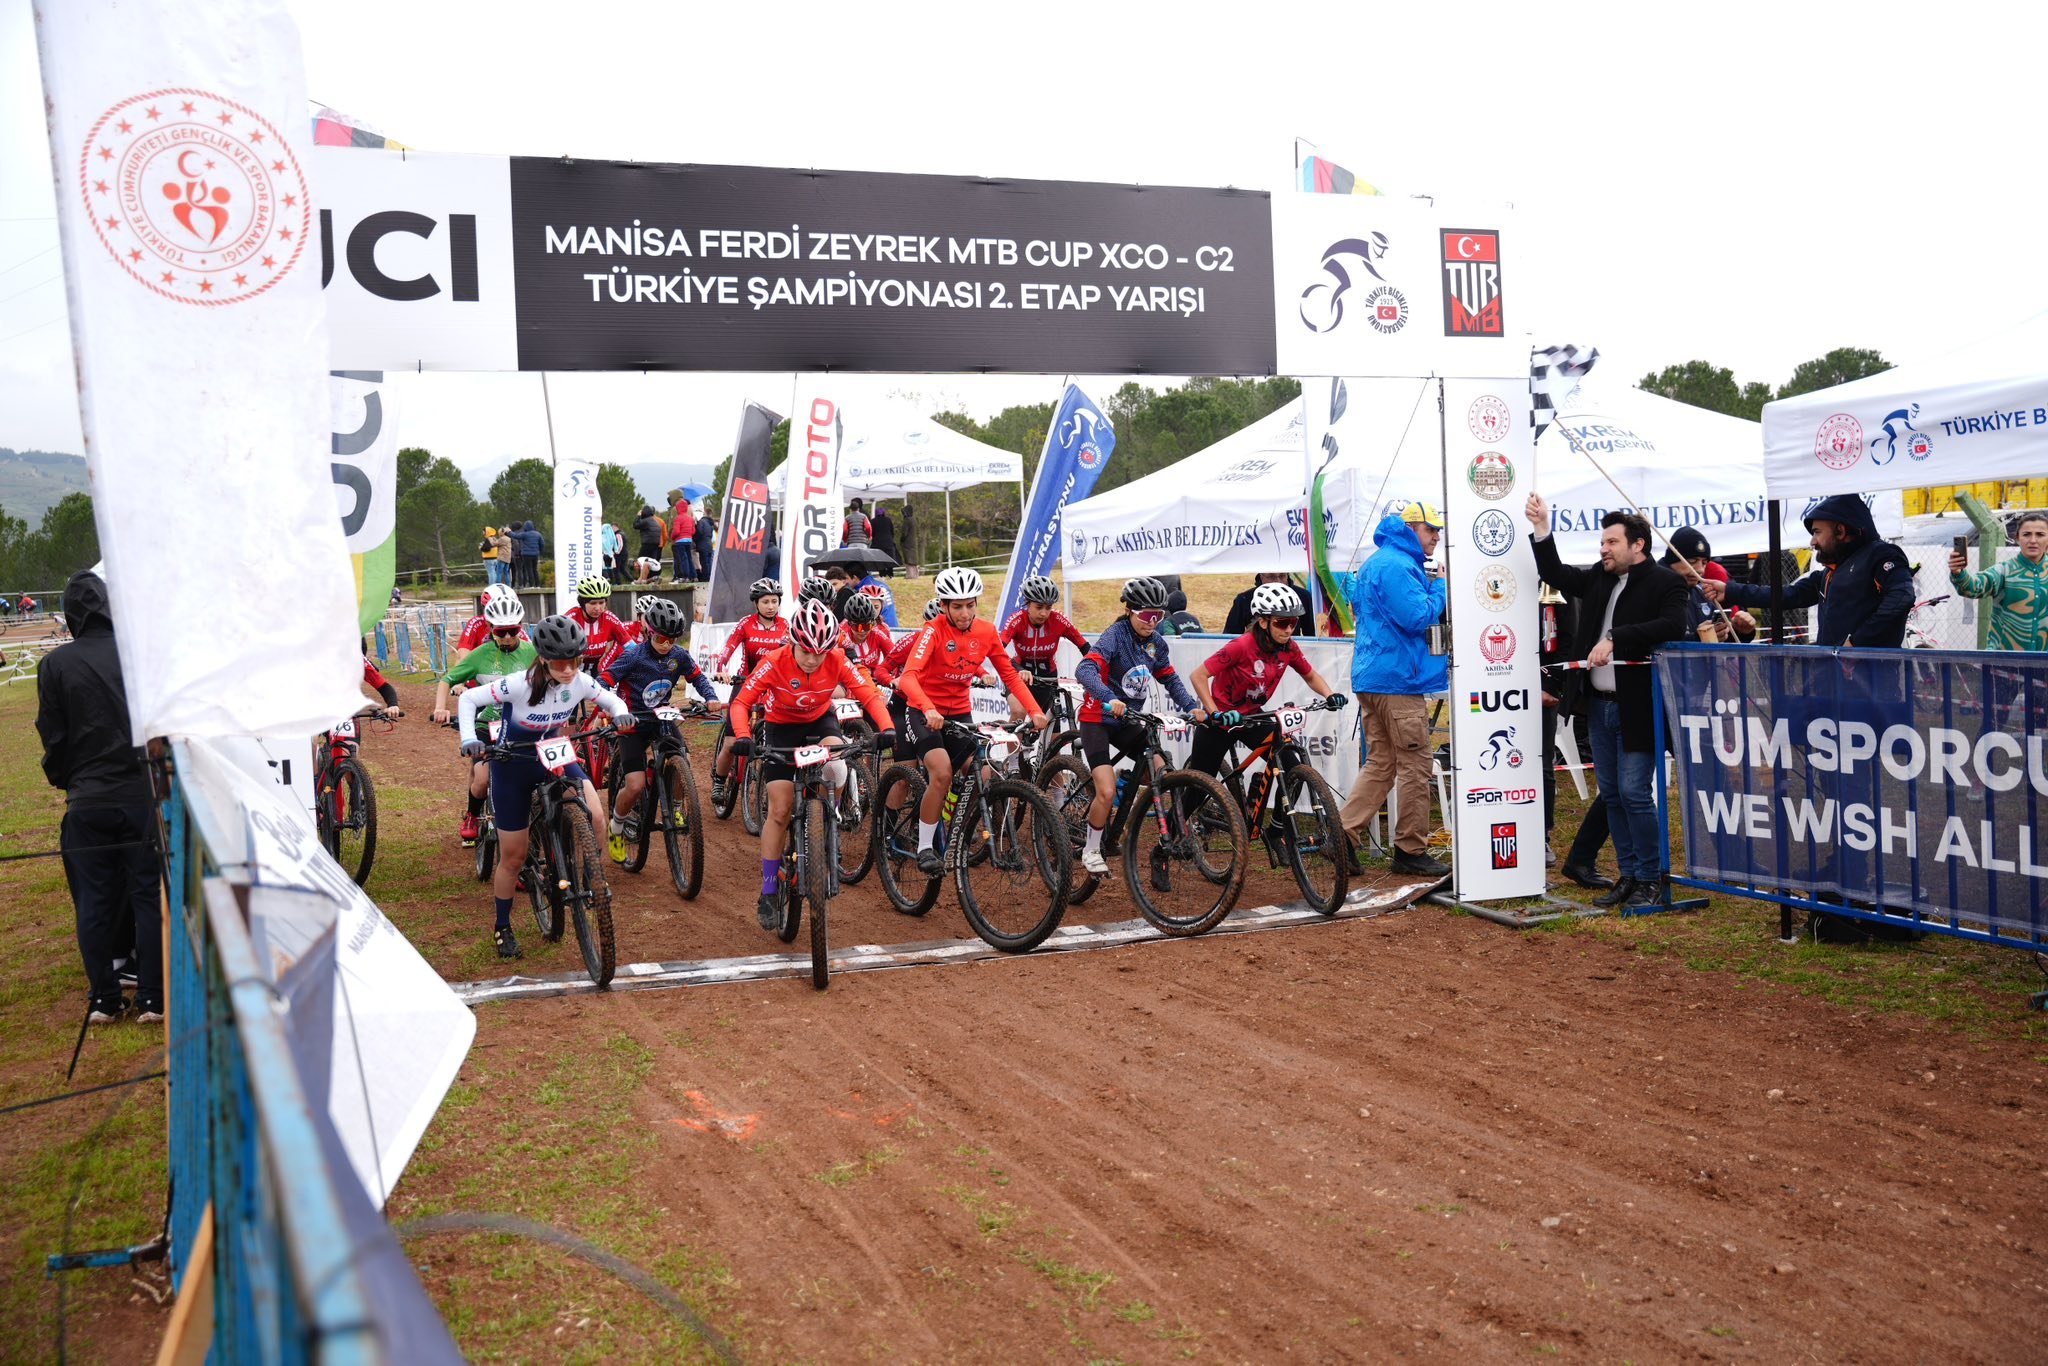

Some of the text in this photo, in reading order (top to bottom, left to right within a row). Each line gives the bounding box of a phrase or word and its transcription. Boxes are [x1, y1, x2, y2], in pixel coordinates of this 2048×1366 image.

[171, 128, 233, 152] GENÇLİK
[234, 146, 250, 165] VE
[122, 131, 169, 213] CUMHURİYETİ
[246, 164, 268, 202] SPOR
[132, 214, 186, 264] TÜRKİYE
[545, 219, 693, 258] MANİSA
[699, 223, 800, 260] FERDİ
[808, 232, 941, 265] ZEYREK
[948, 237, 1018, 266] MTB
[1025, 239, 1094, 268] CUP
[1099, 242, 1169, 270] XCO
[1195, 245, 1235, 272] C2
[583, 265, 1205, 318] TÜRKİYE ŞAMPİYONASI 2. ETAP YARIŞI
[1940, 410, 2028, 437] TÜRKİYE
[1286, 507, 1333, 527] EKM
[1623, 495, 1767, 530] ELEDİYESİ
[1092, 519, 1263, 556] T.C. AKHİSAR BELEDİYESİ
[568, 543, 578, 595] TURKISH
[836, 703, 858, 714] 71
[1481, 688, 1529, 713] UCI
[1283, 712, 1303, 727] 69
[1680, 698, 1793, 770] TÜM
[544, 744, 567, 761] 67
[1697, 790, 1772, 839] WE
[1934, 816, 2048, 879] ALL
